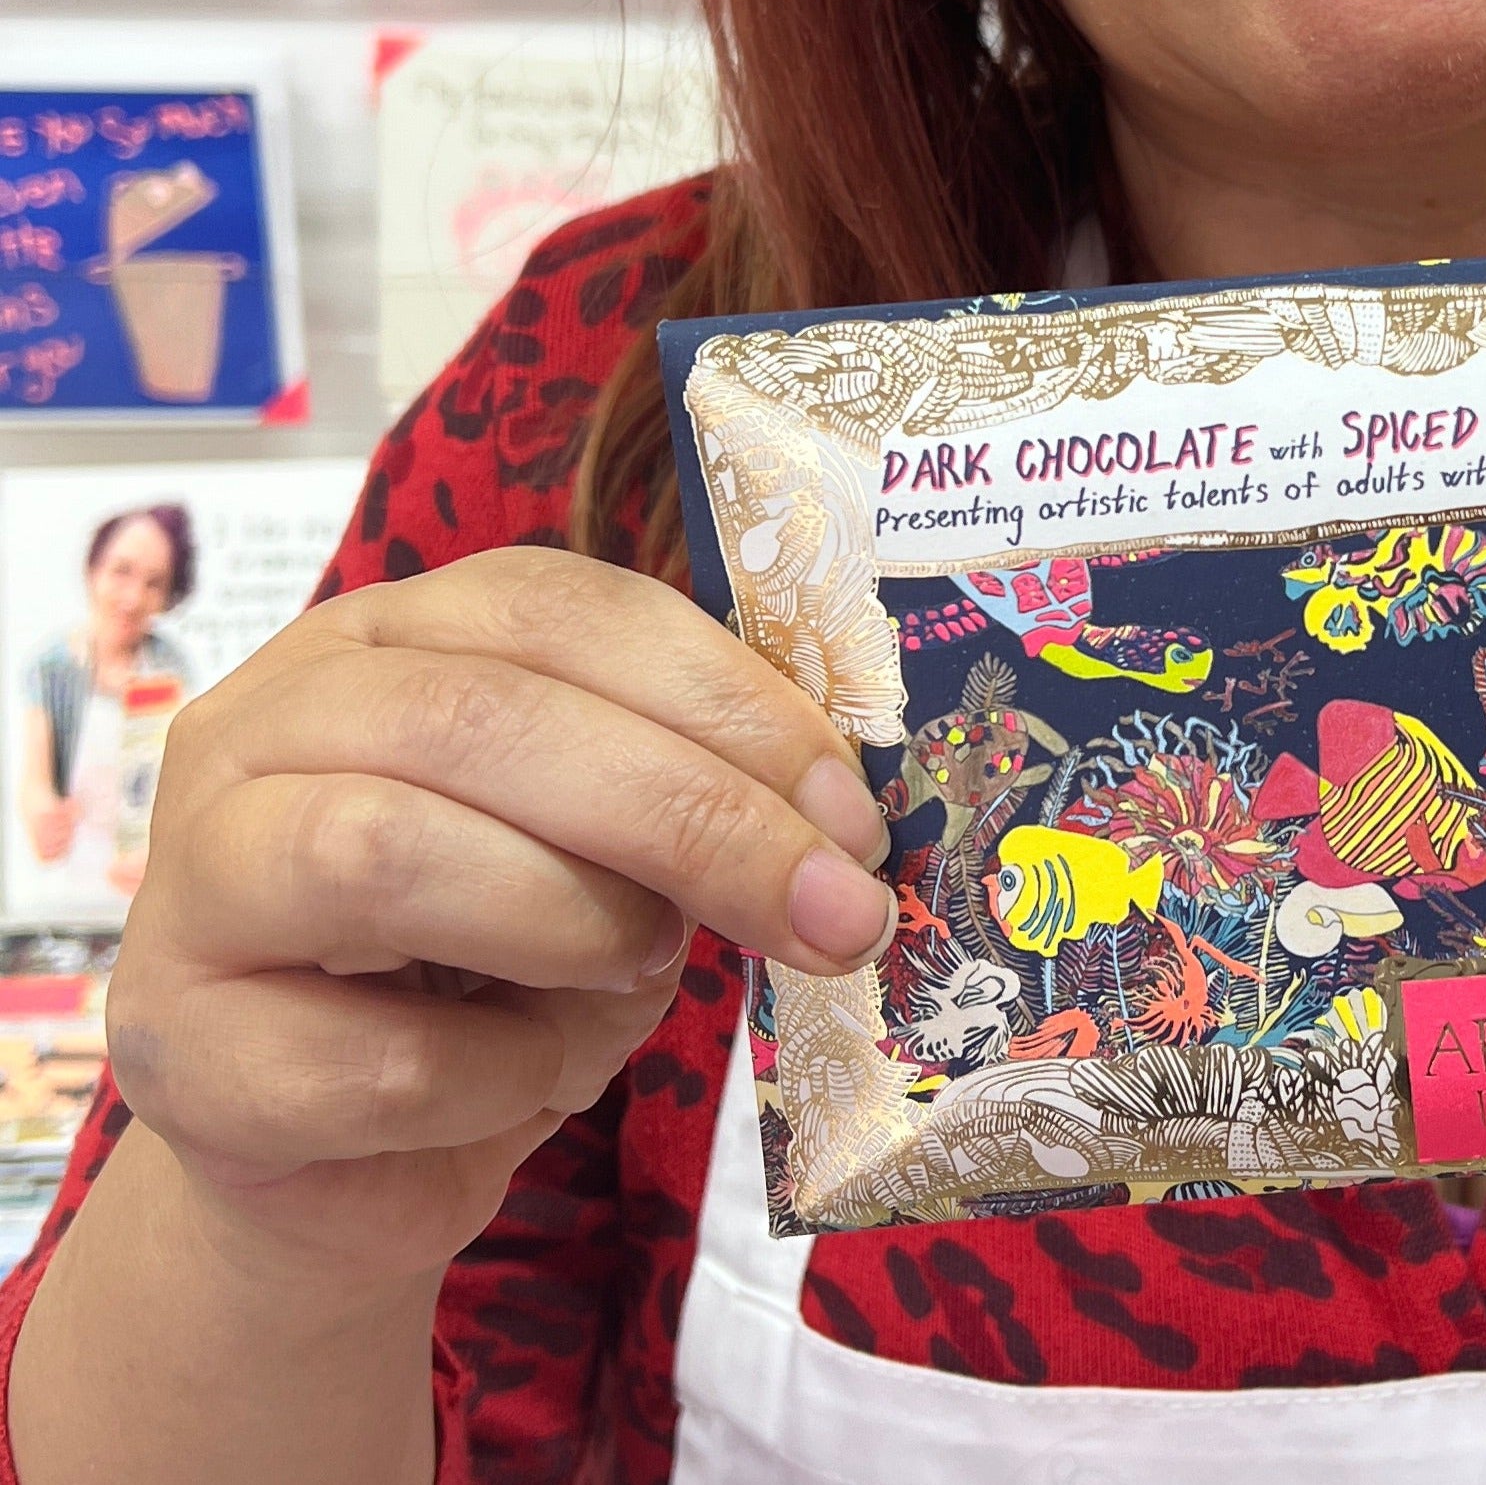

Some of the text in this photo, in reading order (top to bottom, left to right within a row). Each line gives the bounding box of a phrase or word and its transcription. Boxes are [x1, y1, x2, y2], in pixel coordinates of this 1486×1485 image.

[880, 442, 992, 494] DARK
[1015, 422, 1259, 483] CHOCOLATE
[1269, 432, 1324, 461] with
[1341, 406, 1479, 459] SPICED
[1038, 483, 1150, 521] artistic
[1164, 474, 1269, 511] talents
[1284, 471, 1320, 501] of
[1336, 462, 1425, 497] adults
